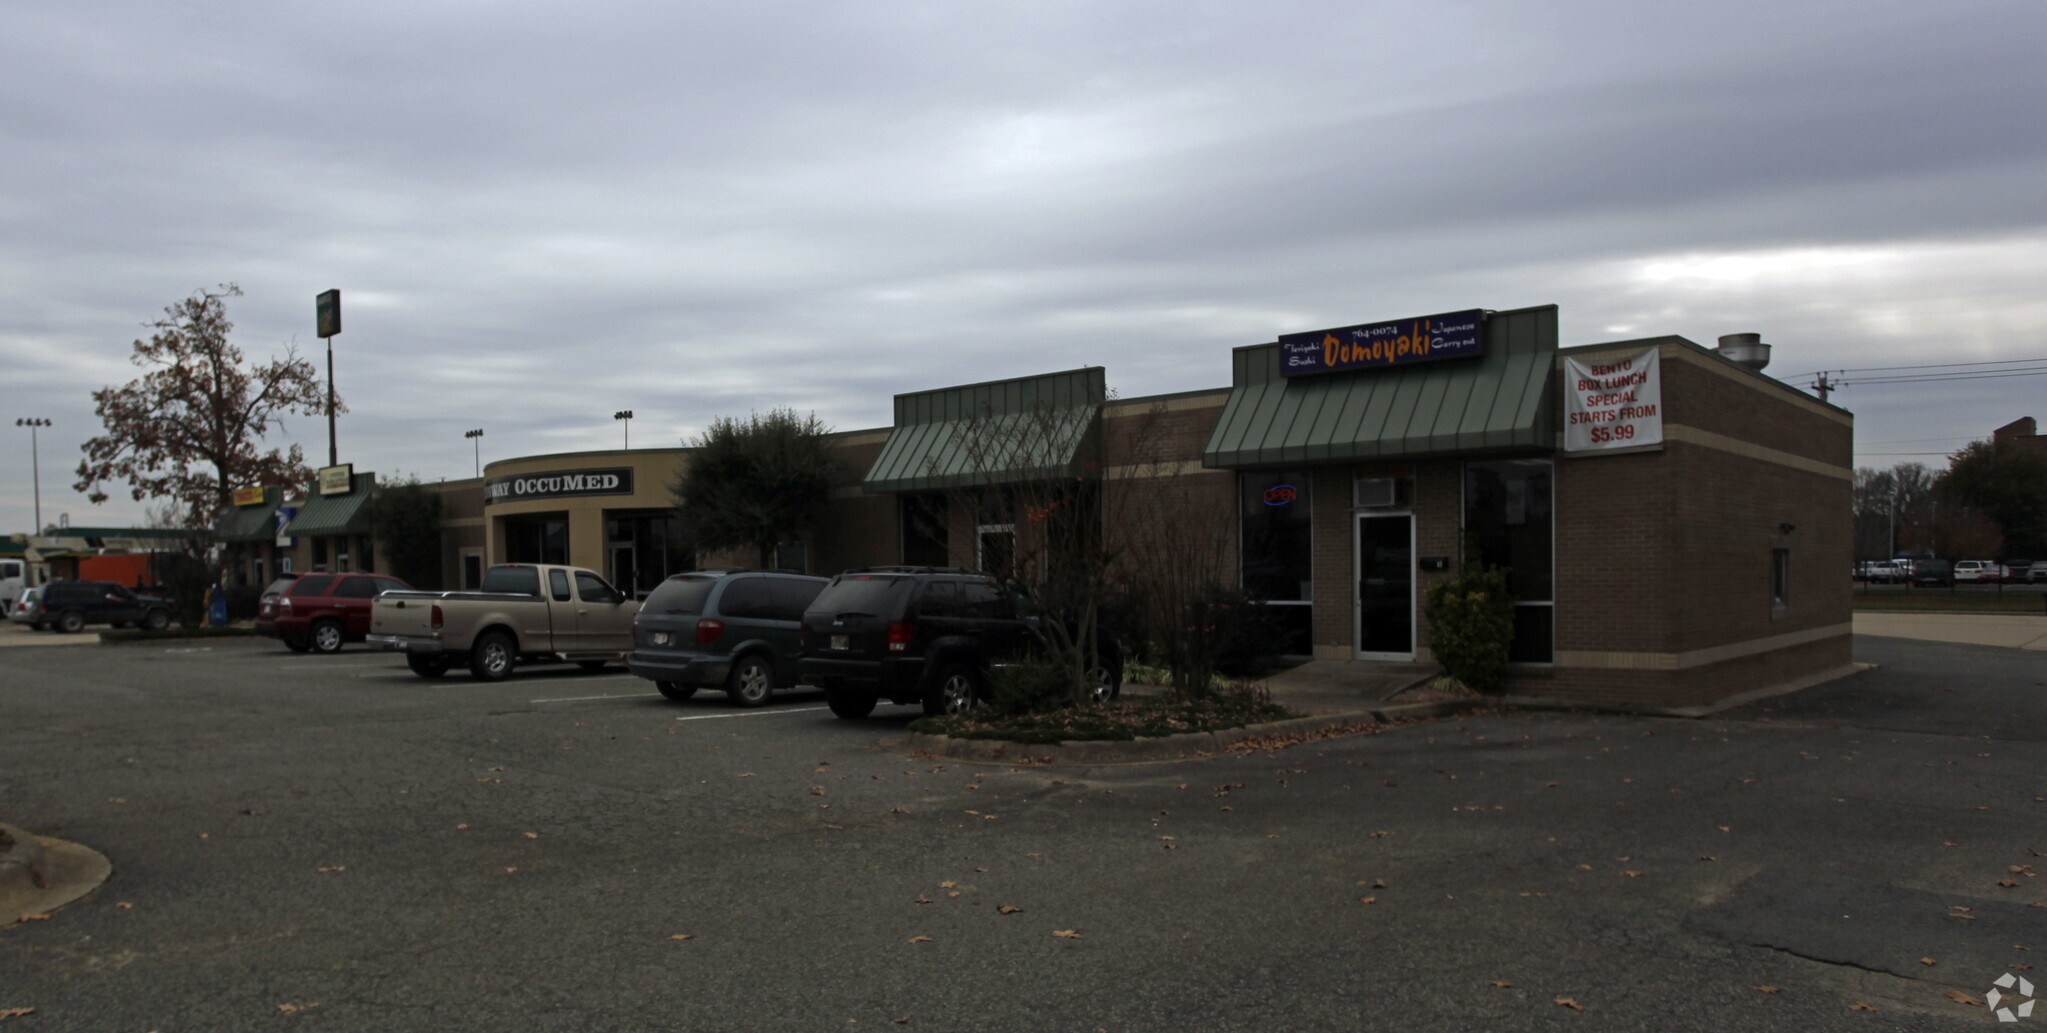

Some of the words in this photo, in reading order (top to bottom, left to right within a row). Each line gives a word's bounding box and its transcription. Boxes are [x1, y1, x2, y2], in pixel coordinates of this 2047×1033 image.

[1352, 325, 1398, 340] 764-0074
[1431, 321, 1475, 334] Japanese
[1283, 341, 1320, 354] Teriyaki
[1322, 319, 1431, 368] Domoyaki
[1463, 336, 1476, 346] out
[1288, 355, 1316, 367] Sushi
[1591, 359, 1632, 376] BENTO
[1578, 379, 1602, 391] BOX
[1605, 371, 1647, 389] LUNCH
[1587, 391, 1638, 407] SPECIAL
[1570, 410, 1616, 425] STARTS
[1619, 404, 1656, 420] FROM
[1591, 424, 1634, 443] $5.99
[514, 474, 620, 495] OCCUMED
[1263, 488, 1297, 503] OPEN
